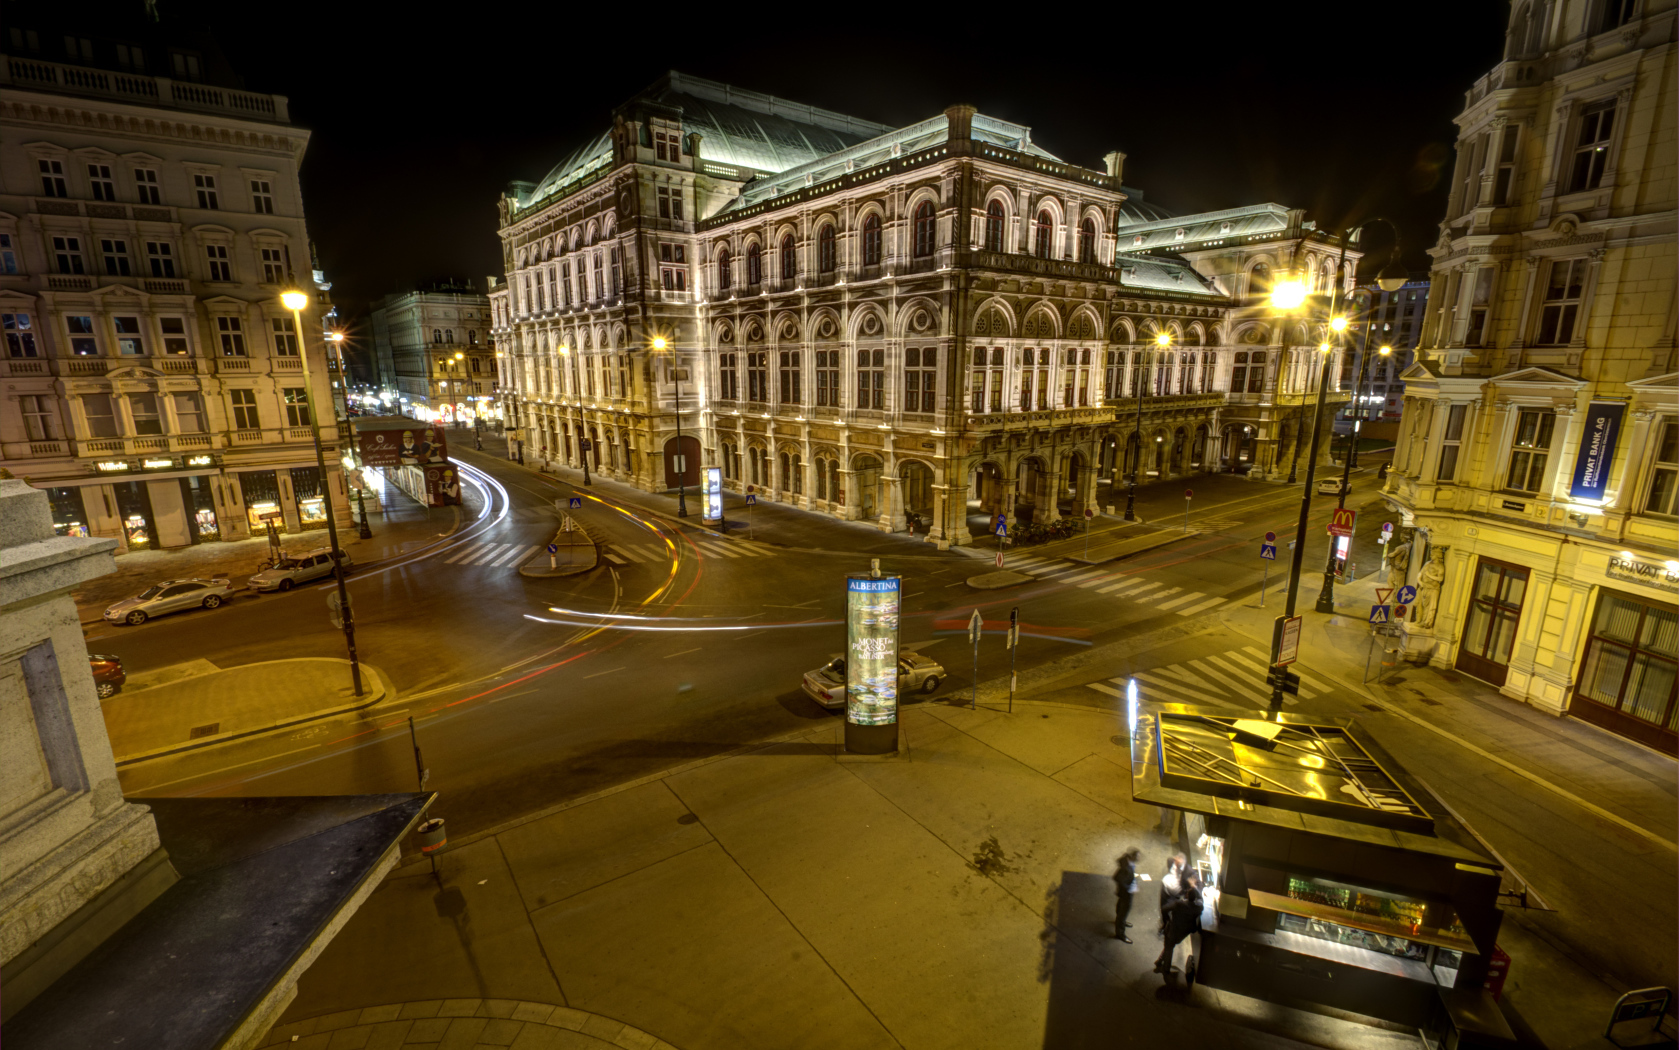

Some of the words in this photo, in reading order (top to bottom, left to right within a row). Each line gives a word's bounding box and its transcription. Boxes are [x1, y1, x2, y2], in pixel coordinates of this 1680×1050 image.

[1582, 457, 1596, 487] PRIVAT
[1589, 431, 1602, 456] BANK
[1596, 417, 1606, 430] AG
[98, 461, 128, 471] Wilhelm
[1610, 558, 1661, 579] PRIVAT
[850, 581, 897, 591] ALBERTINA
[858, 637, 888, 646] MONET
[852, 642, 886, 652] PICASSO
